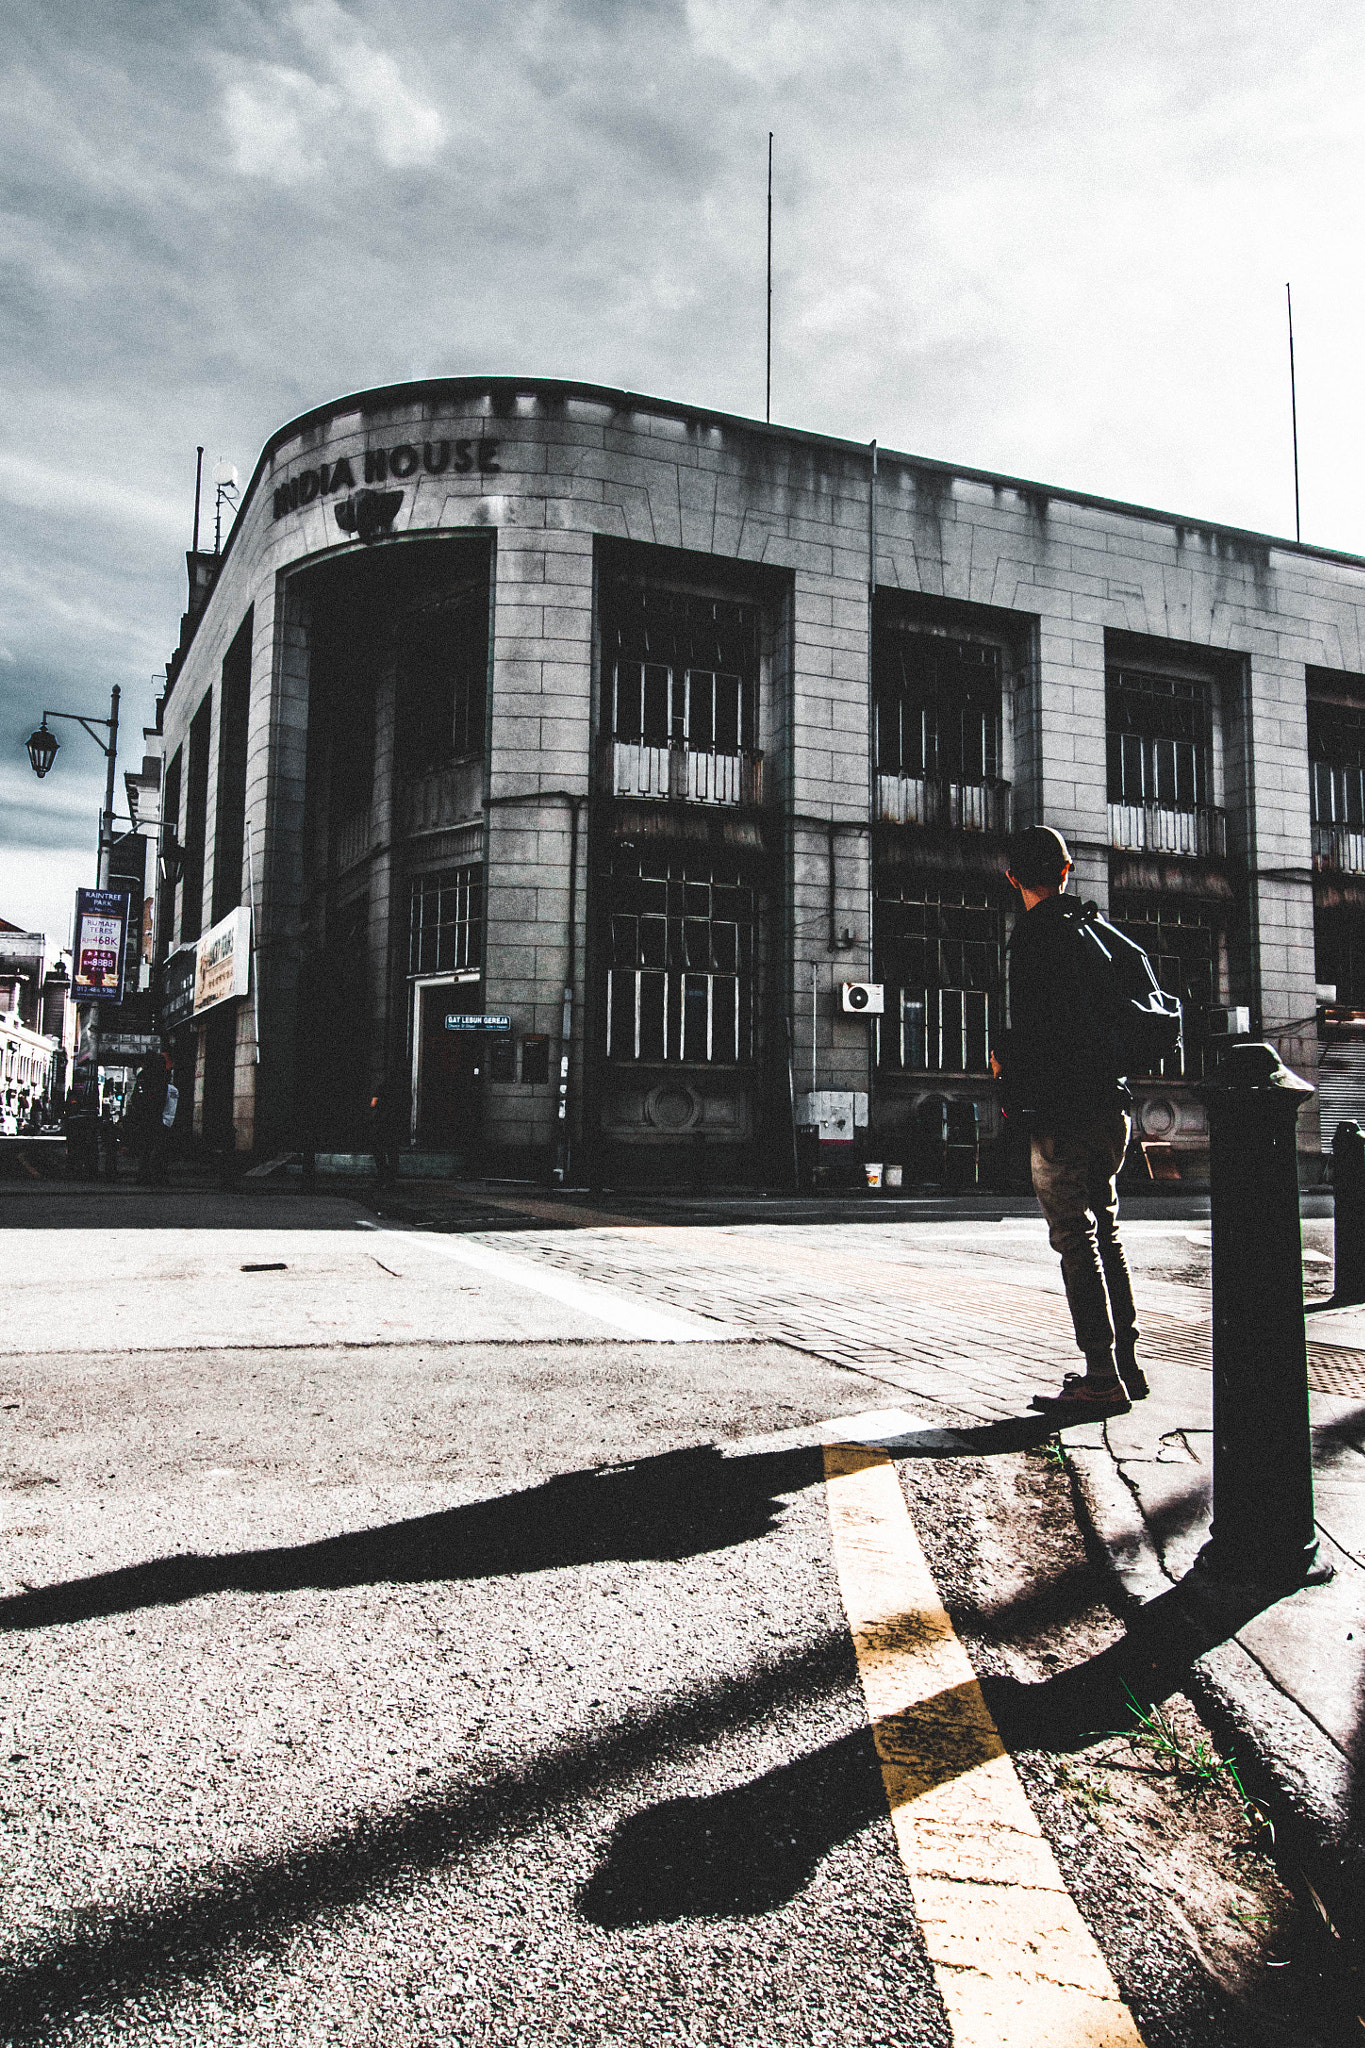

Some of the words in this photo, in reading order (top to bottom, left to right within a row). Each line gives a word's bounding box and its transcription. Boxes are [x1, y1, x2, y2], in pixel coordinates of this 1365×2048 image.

[273, 457, 355, 519] INDIA
[365, 438, 501, 484] HOUSE
[86, 892, 122, 901] RAINTREE
[93, 899, 112, 907] PARK
[87, 919, 117, 928] RUMAH
[90, 927, 113, 935] TERES
